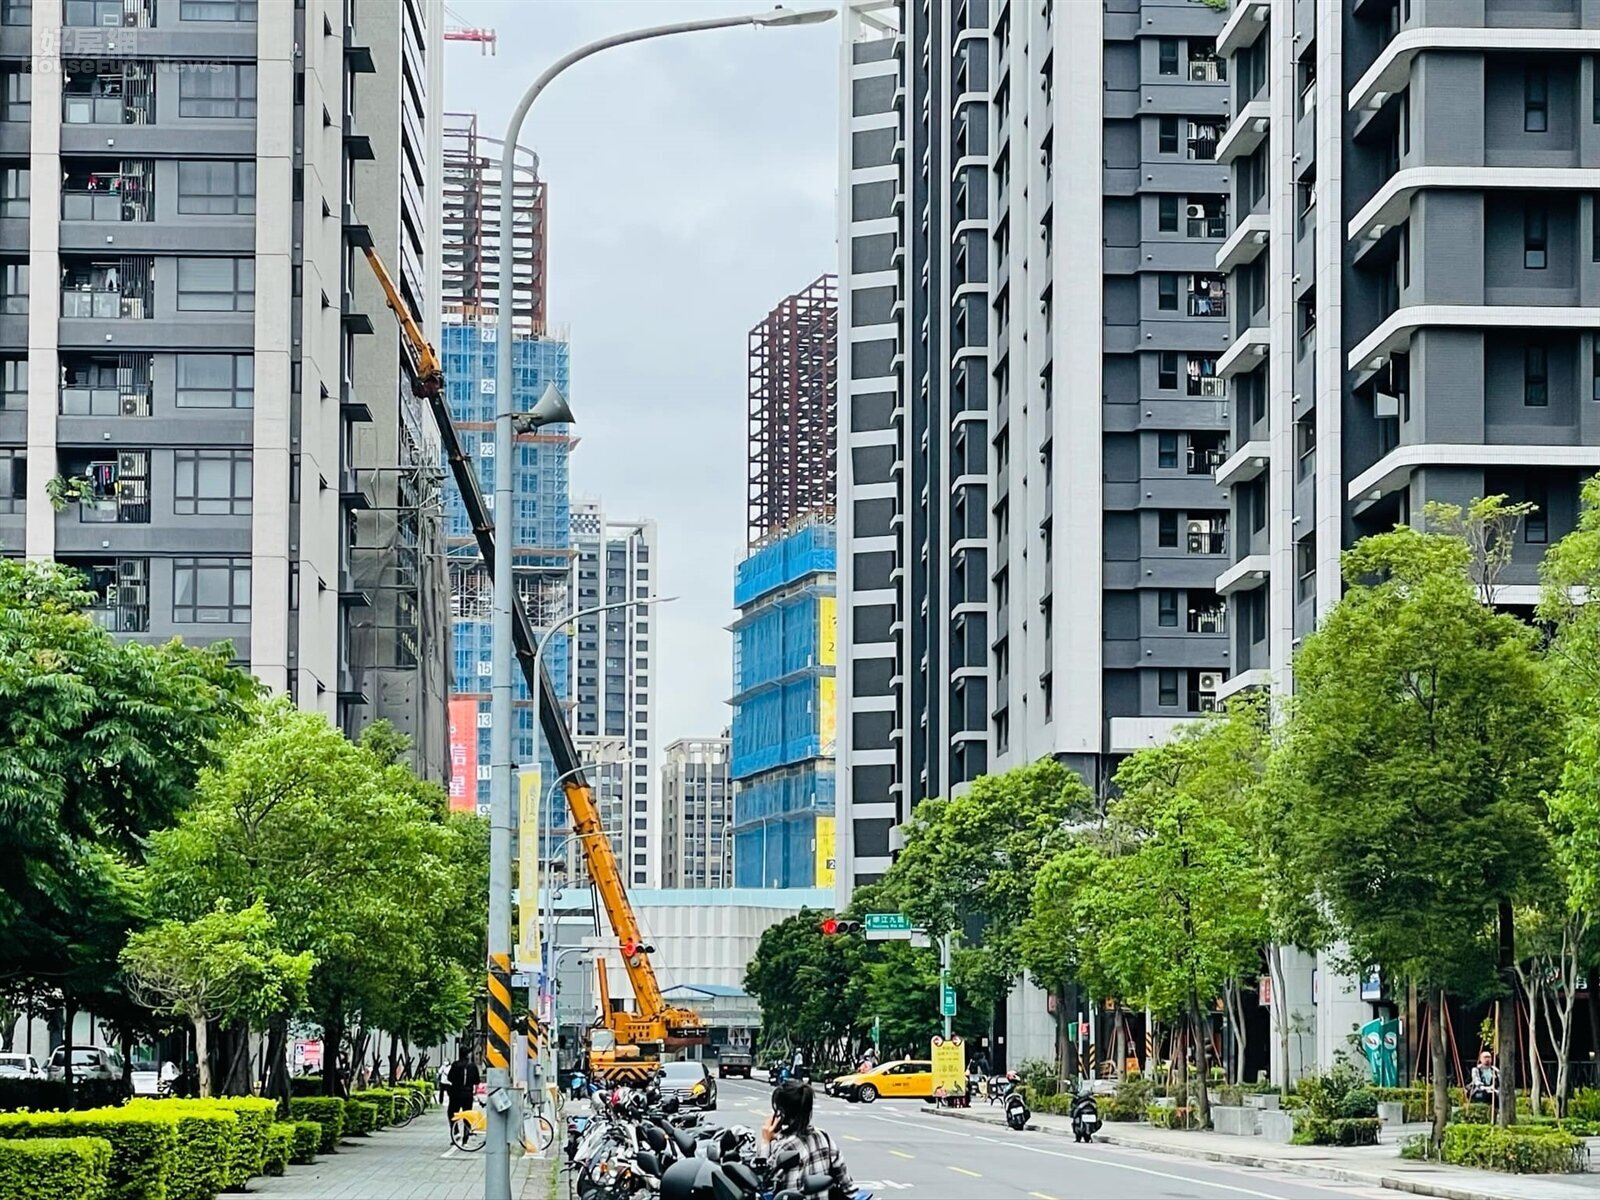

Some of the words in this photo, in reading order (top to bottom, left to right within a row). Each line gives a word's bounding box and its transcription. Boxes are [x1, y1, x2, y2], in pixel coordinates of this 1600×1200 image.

[482, 330, 495, 340] 27
[482, 381, 495, 392] 25
[481, 444, 494, 456] 23
[479, 662, 491, 674] 15
[479, 714, 491, 726] 13
[479, 767, 490, 779] 11
